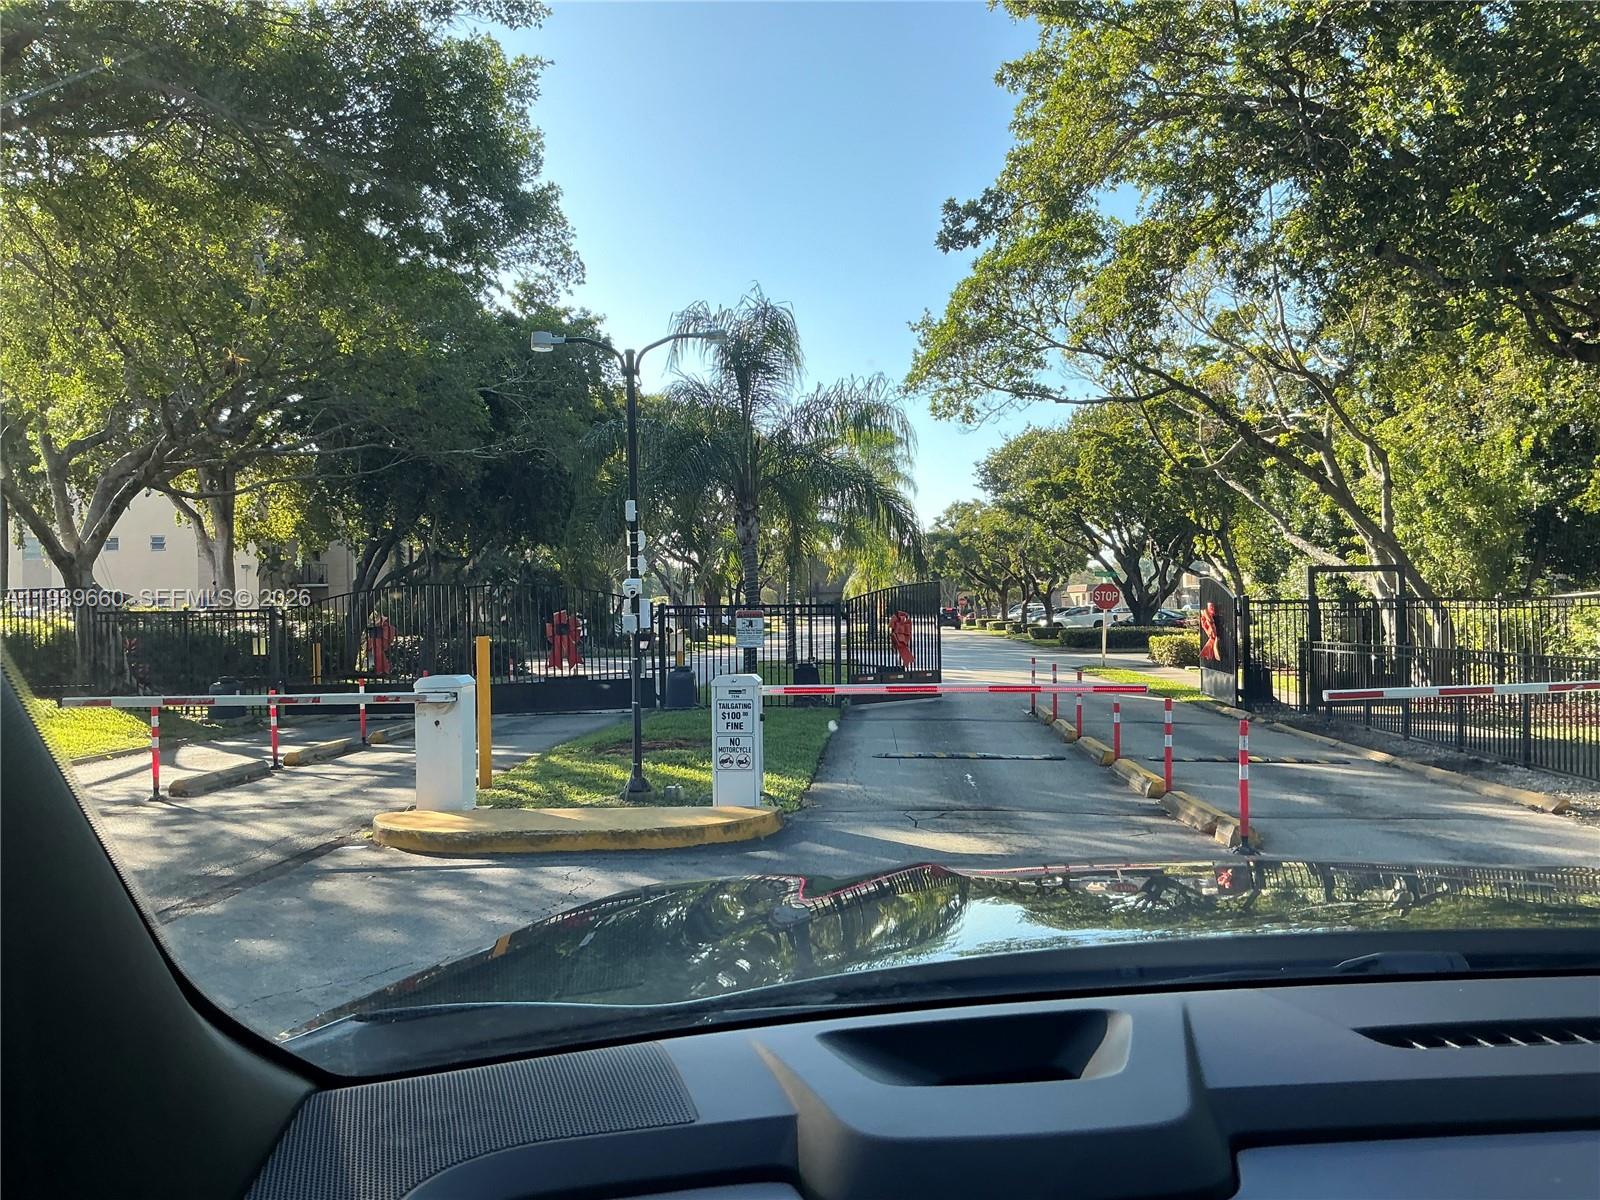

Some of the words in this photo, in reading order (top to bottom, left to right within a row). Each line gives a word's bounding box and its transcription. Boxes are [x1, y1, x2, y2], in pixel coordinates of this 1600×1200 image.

[1094, 591, 1119, 602] STOP
[718, 702, 752, 710] TAILGATING
[721, 711, 741, 720] $100
[726, 722, 744, 730] FINE
[729, 737, 741, 747] NO
